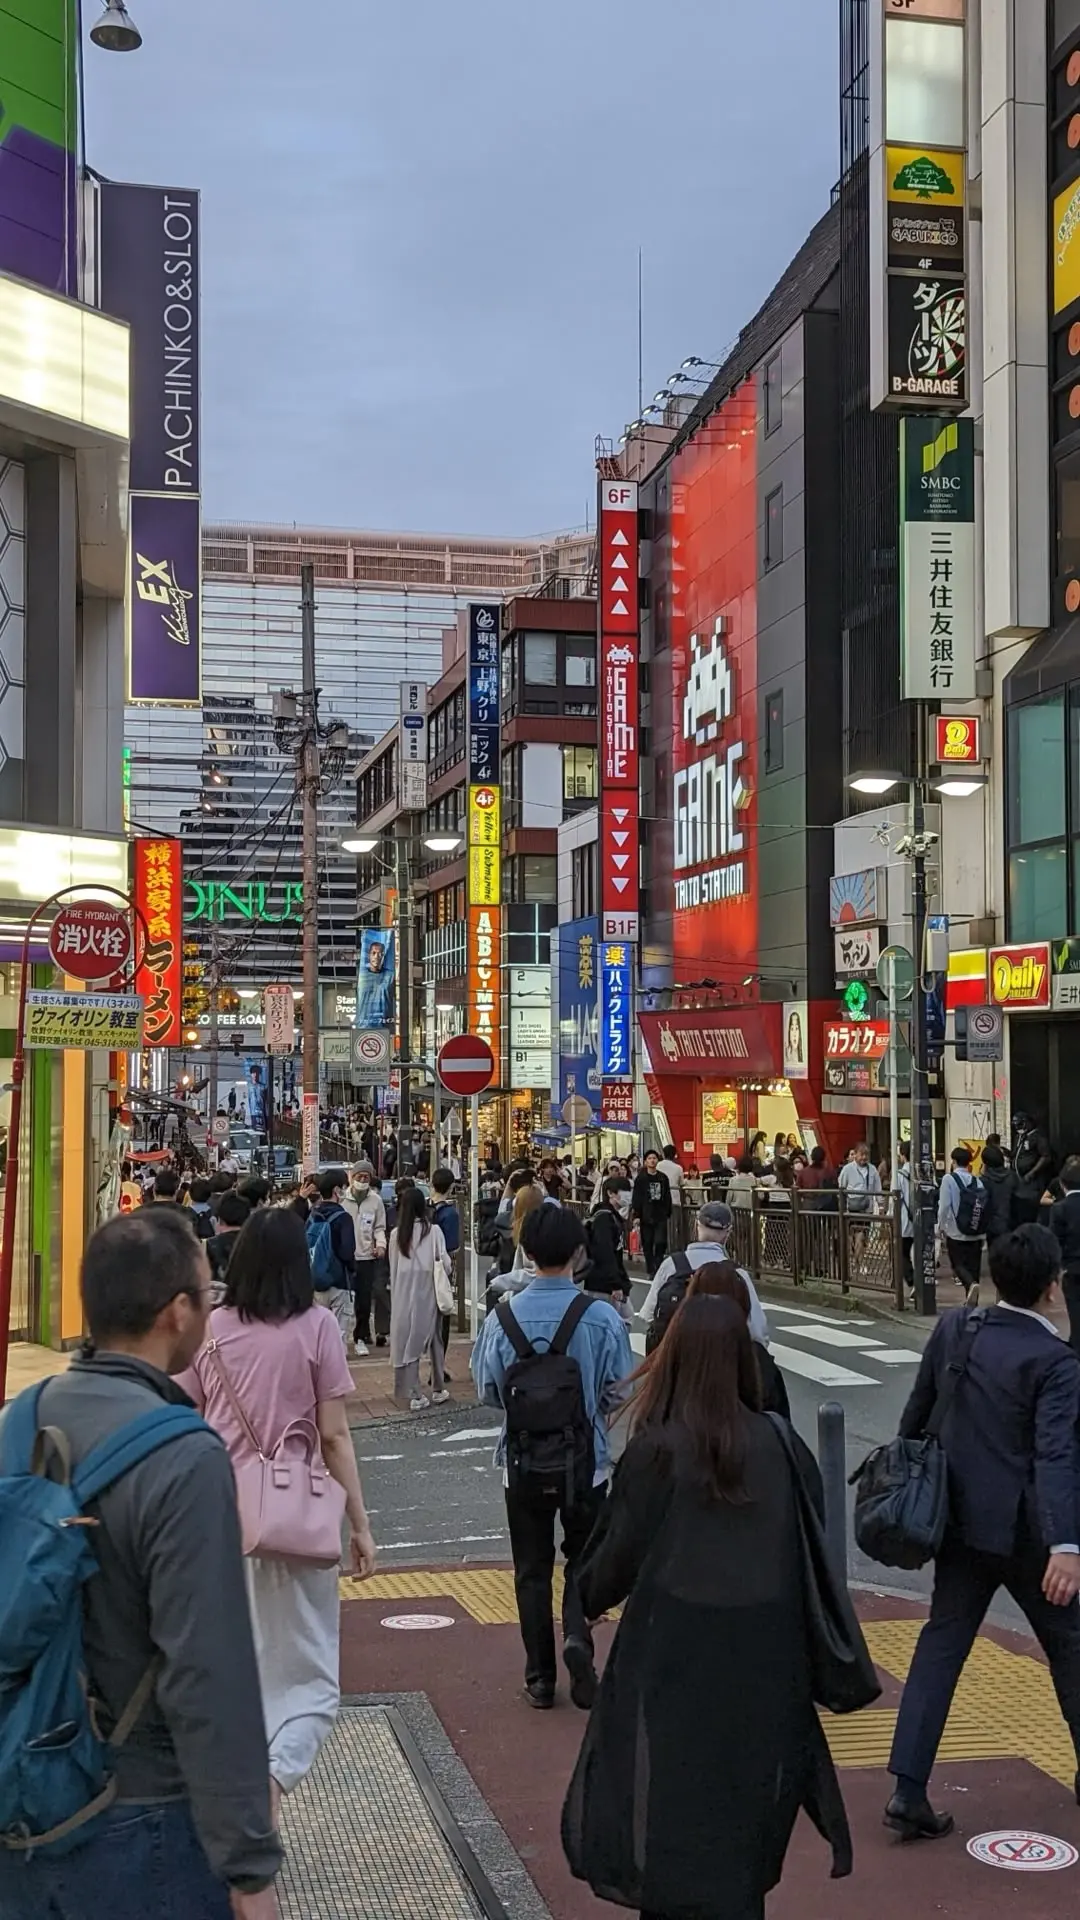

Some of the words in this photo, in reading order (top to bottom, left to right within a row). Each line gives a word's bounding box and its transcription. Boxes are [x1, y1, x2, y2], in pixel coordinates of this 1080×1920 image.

[918, 259, 932, 269] 4F
[913, 282, 940, 372] ダーツ
[164, 196, 193, 487] PACHINKO&SLOT
[893, 377, 959, 395] B-GARAGE
[921, 476, 960, 489] SMBC
[608, 488, 631, 503] 6F
[136, 552, 171, 604] EX
[929, 532, 953, 688] 三井住友銀行
[476, 632, 489, 764] 東京上野クリニック
[614, 667, 634, 778] GAME
[476, 791, 494, 806] 4F
[674, 741, 748, 870] GAME
[484, 812, 494, 841] Yellow
[674, 875, 700, 910] TAITO
[702, 862, 743, 904] STATION
[66, 910, 83, 919] FIRE
[85, 912, 120, 922] HYDRANT
[606, 920, 637, 934] B1F
[56, 923, 126, 957] 消火栓
[144, 843, 174, 1043] 横浜家系ラーメン
[605, 946, 625, 966] 薬
[517, 971, 525, 981] 2
[993, 956, 1045, 1002] Daily
[1060, 985, 1080, 1004] 三井
[32, 1007, 139, 1029] ヴァイオリン教室
[197, 1014, 237, 1025] OFEE
[519, 1012, 524, 1021] 1
[608, 971, 626, 1073] ハックドラッグ
[84, 1038, 139, 1049] 045-314-3980
[675, 1030, 706, 1057] TAITO
[703, 1028, 749, 1058] STATION
[828, 1027, 875, 1053] カラオケ
[516, 1052, 527, 1062] B1
[606, 1086, 629, 1096] TAX
[603, 1098, 632, 1108] FREE
[606, 1110, 628, 1121] 免税
